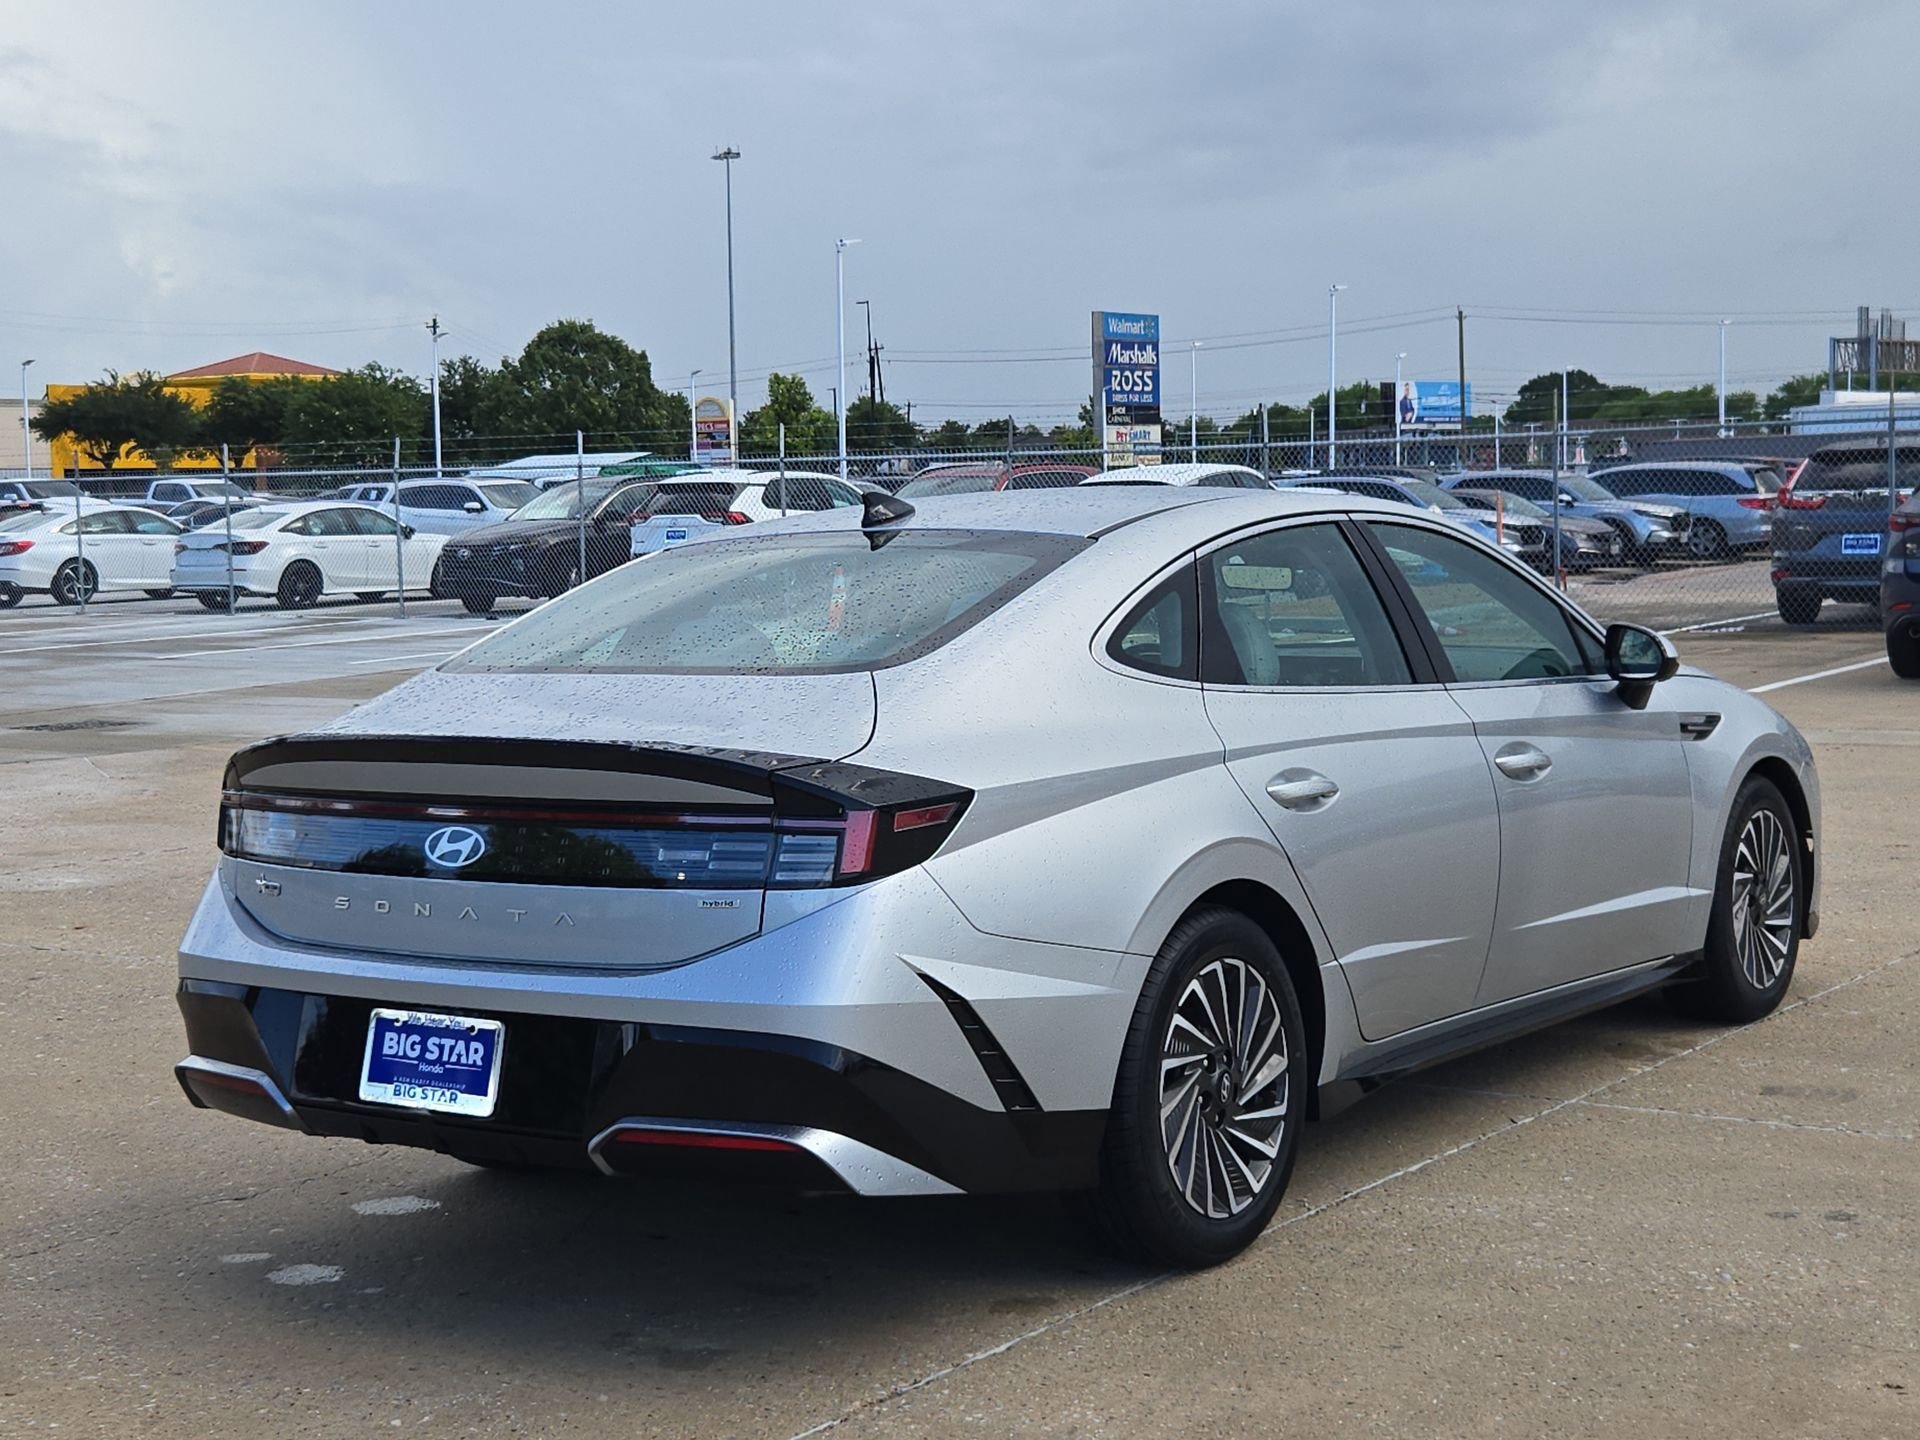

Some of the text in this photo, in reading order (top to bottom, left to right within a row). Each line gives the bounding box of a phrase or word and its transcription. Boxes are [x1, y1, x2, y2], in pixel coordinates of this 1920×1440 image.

[1108, 317, 1144, 334] Walmart
[1107, 342, 1157, 365] Marshalls
[1111, 370, 1153, 392] ROSS
[1129, 393, 1140, 402] FOR
[1140, 393, 1153, 402] LESS
[334, 895, 575, 926] SONATA
[702, 899, 734, 907] hybrid
[407, 1012, 466, 1029] We Hear You
[382, 1032, 485, 1066] BIG STAR
[418, 1062, 444, 1074] Honda
[393, 1084, 458, 1104] BIG STAR
